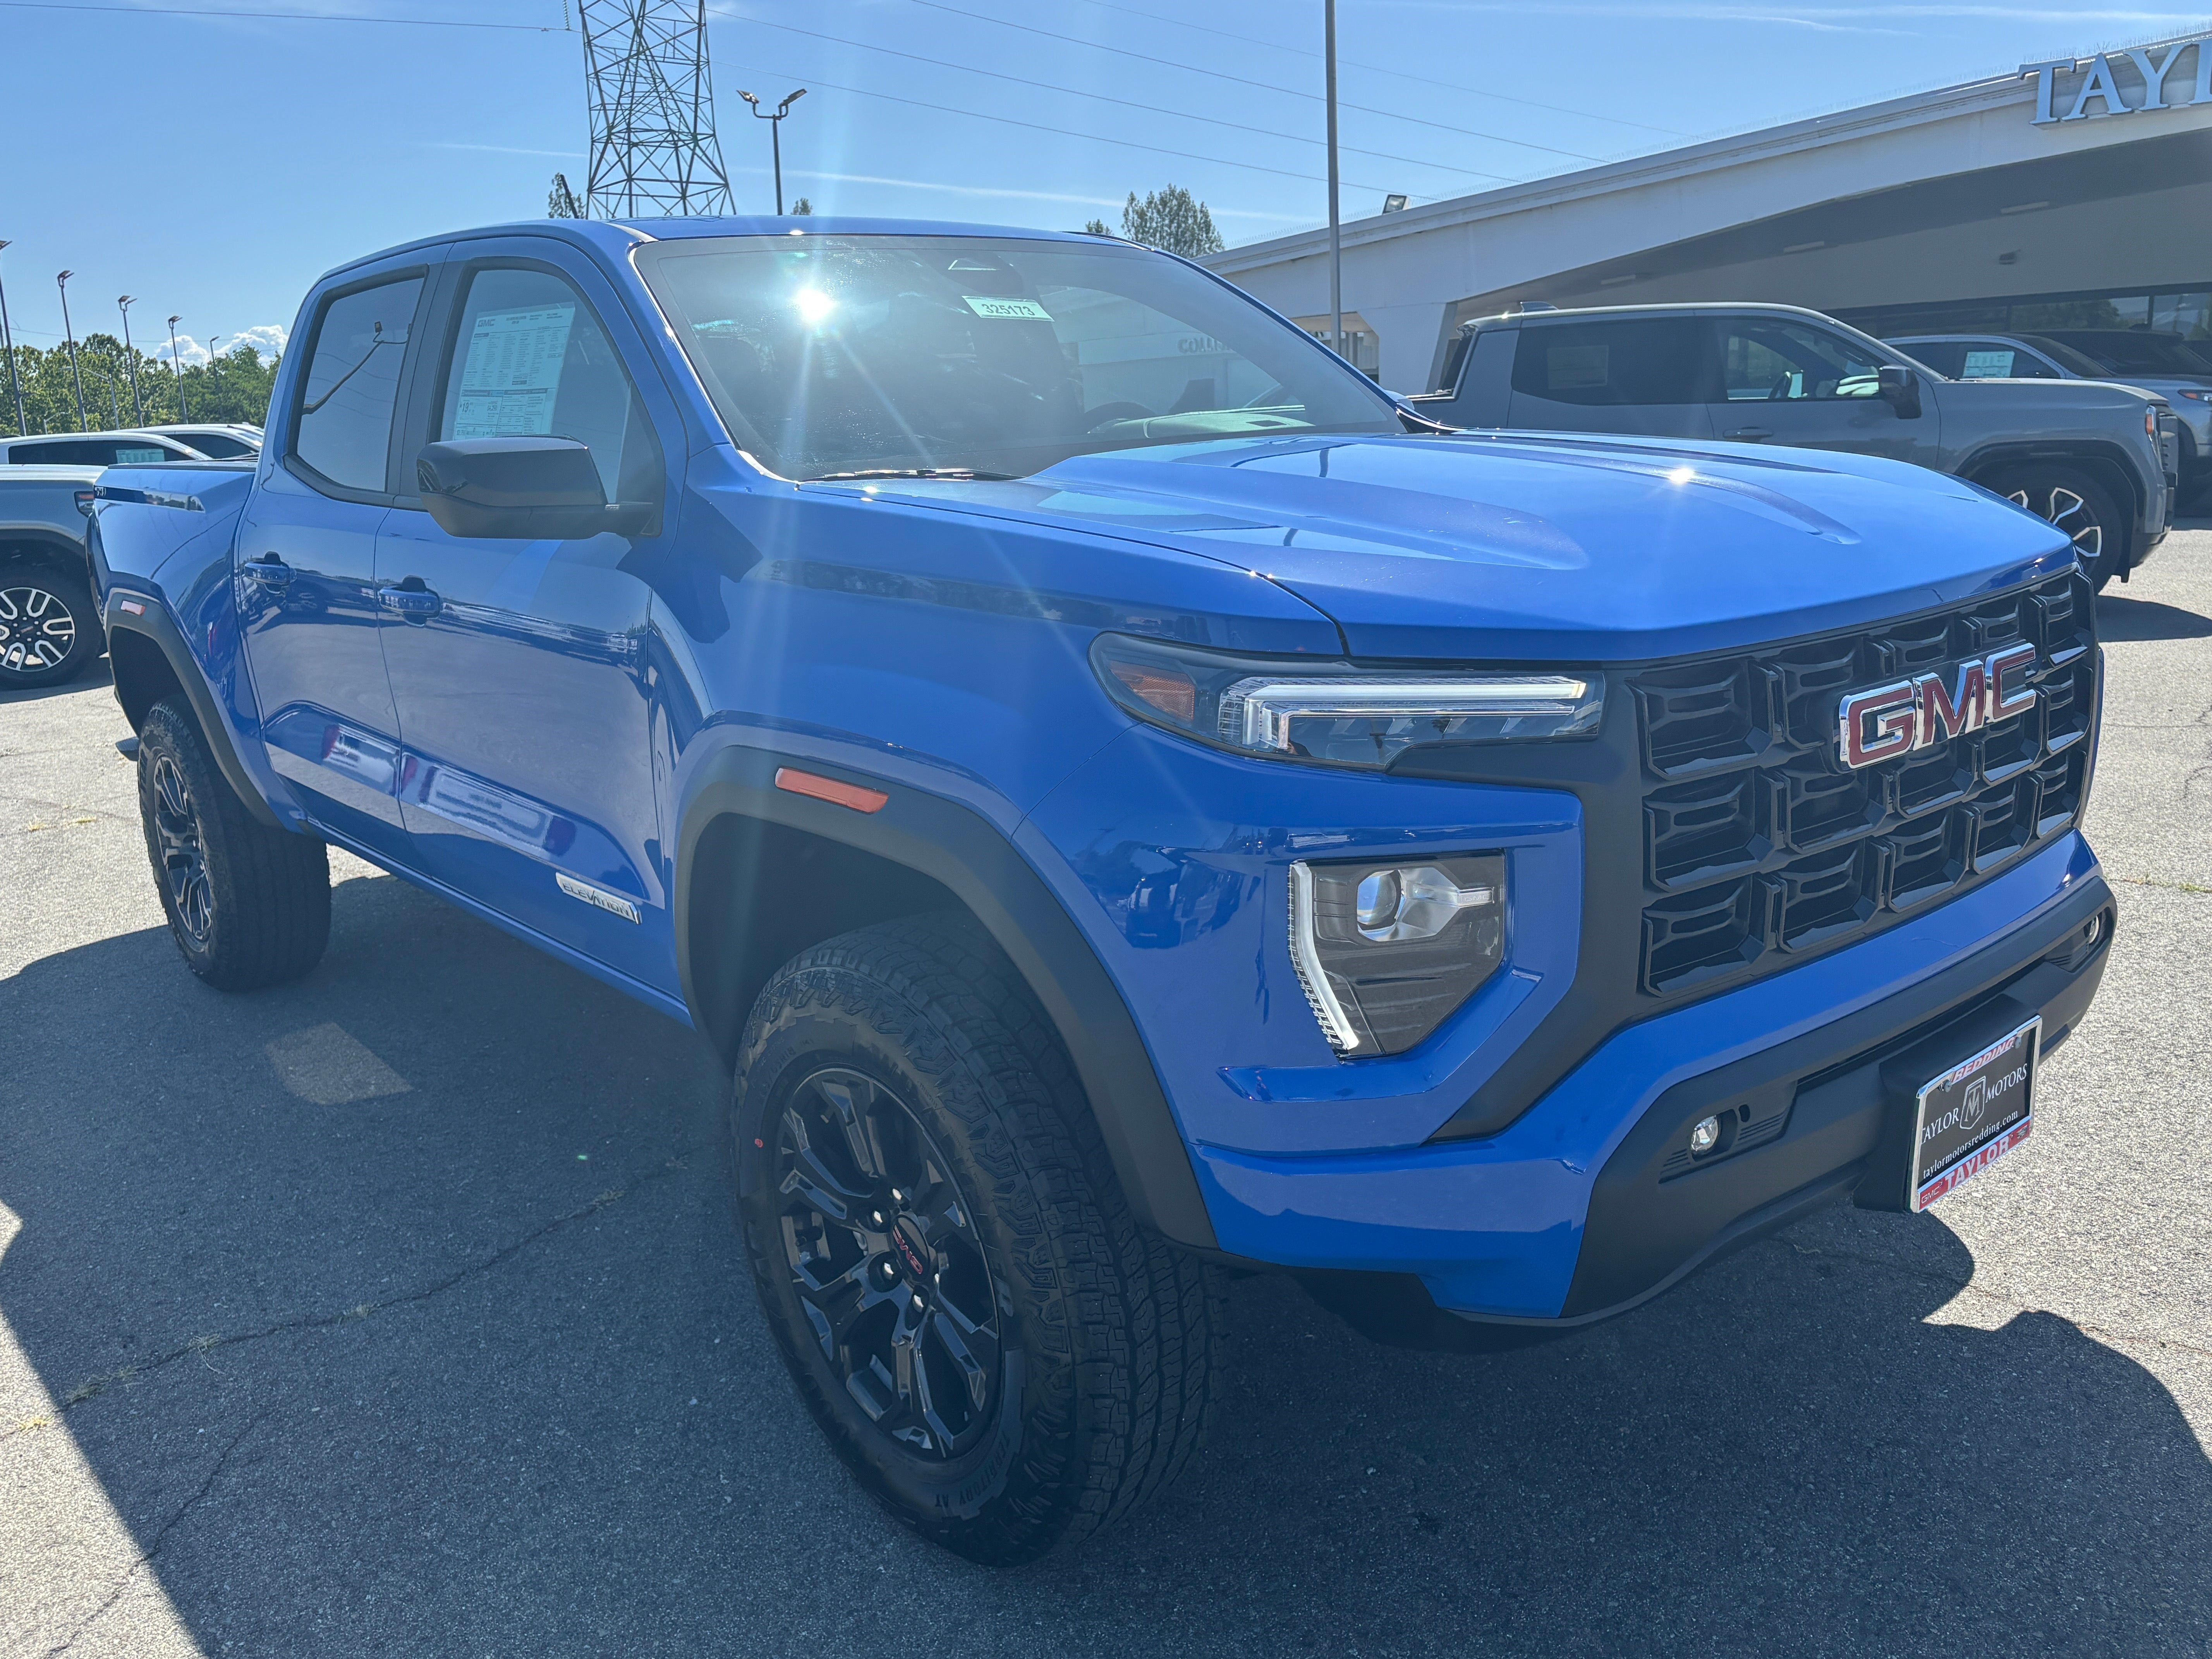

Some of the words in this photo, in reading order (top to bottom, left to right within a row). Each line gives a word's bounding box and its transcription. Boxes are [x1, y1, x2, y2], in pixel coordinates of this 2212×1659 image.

[477, 318, 496, 328] GMC
[981, 304, 1035, 316] 325173
[1839, 642, 2036, 769] GMC
[562, 882, 631, 917] ELEVATION
[1953, 1037, 2015, 1082] REDDING
[1985, 1063, 2027, 1103] MOTORS
[1923, 1111, 2018, 1179] taylormotorsredding.com
[1921, 1186, 1940, 1204] GMC
[1945, 1136, 2010, 1191] TAYLOR
[893, 1224, 923, 1274] GMC
[960, 1431, 1010, 1506] TERRITORY
